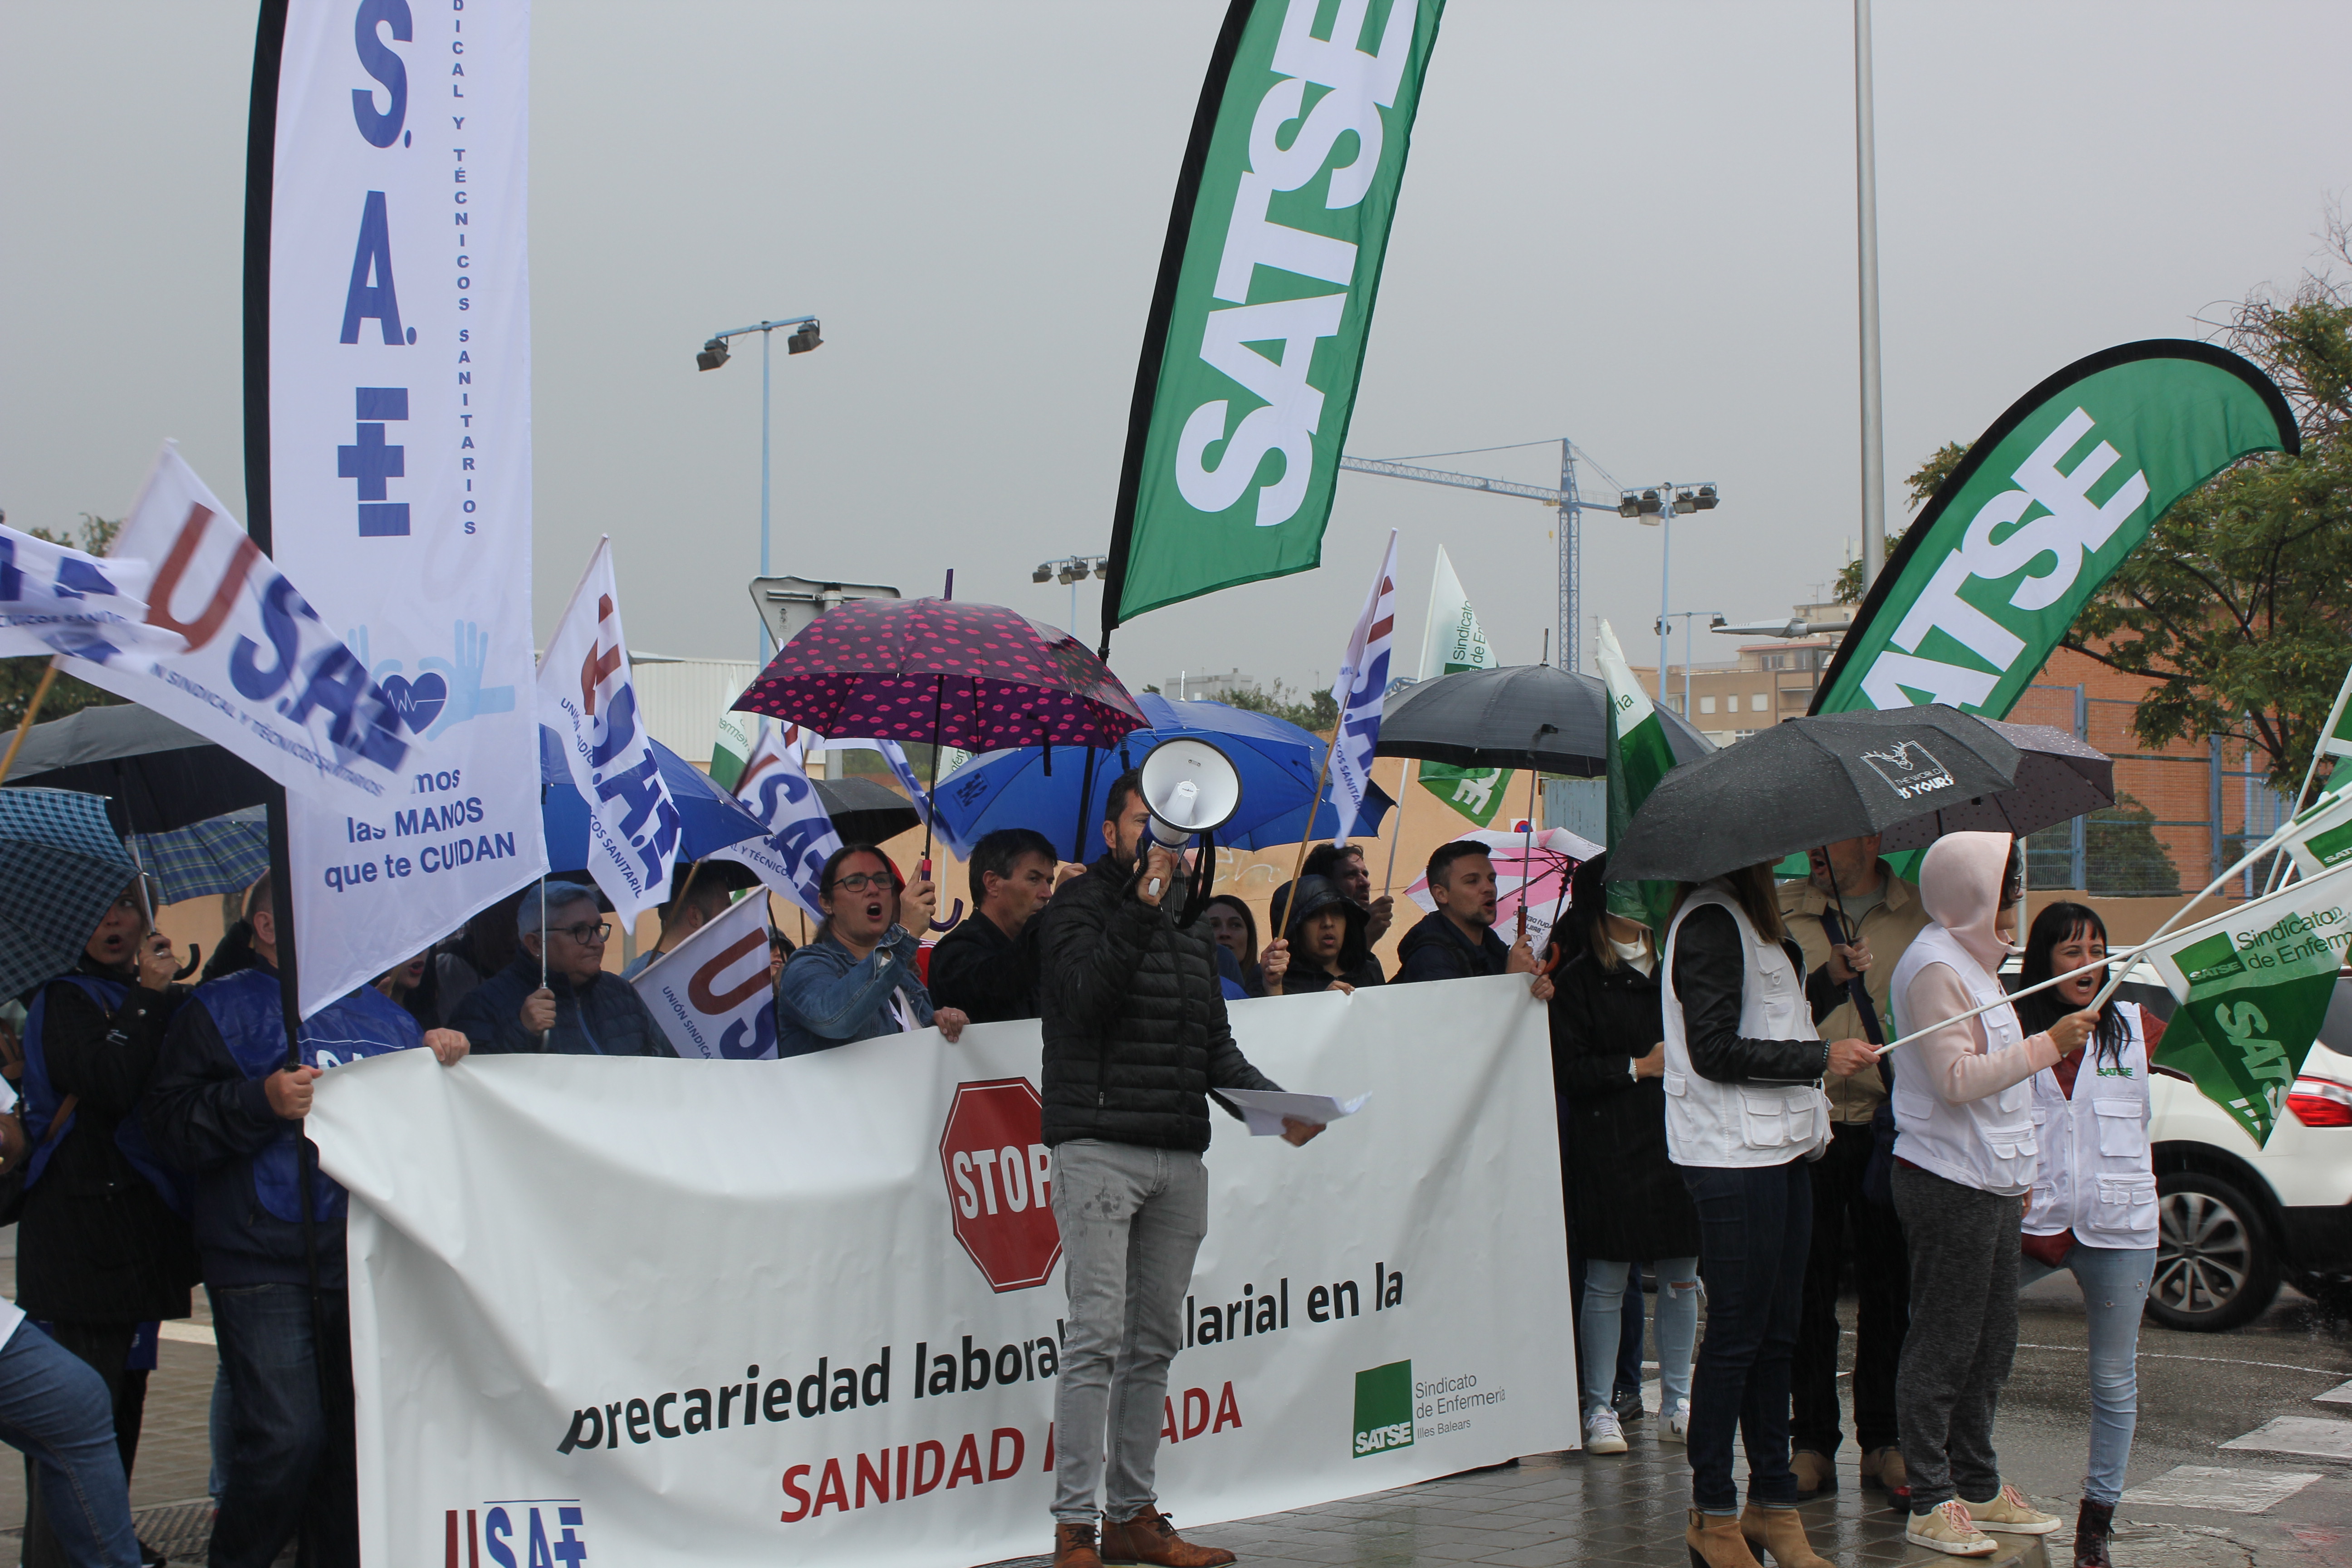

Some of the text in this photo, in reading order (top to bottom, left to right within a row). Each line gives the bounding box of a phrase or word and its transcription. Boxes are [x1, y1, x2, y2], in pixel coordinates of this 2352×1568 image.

[453, 117, 465, 130] Y
[454, 149, 470, 311] TÉCNICOS
[1175, 0, 1418, 527] SATSE
[458, 329, 475, 535] SANITARIOS
[1860, 407, 2151, 710] ATSE
[1470, 646, 1485, 664] de
[1894, 768, 1942, 786] THE WORLD
[1909, 774, 1955, 795] YOURS
[395, 797, 484, 837] MANOS
[325, 832, 516, 892] que te CUIDAN
[741, 846, 749, 855] Y
[2189, 961, 2241, 981] SATSE
[2236, 910, 2335, 951] Sindicato
[2248, 953, 2275, 969] de
[662, 985, 714, 1059] UNIÓN SINDICA
[2096, 1067, 2133, 1076] SATSE
[953, 1143, 1051, 1220] STOP
[556, 1261, 1403, 1455] precariedad laboral larial en la
[1415, 1374, 1477, 1399] Sindicato
[1416, 1386, 1506, 1419] de Enfermería
[1355, 1421, 1412, 1454] SATSE
[1417, 1419, 1471, 1439] Illes Balears
[779, 1426, 1024, 1524] SANIDAD
